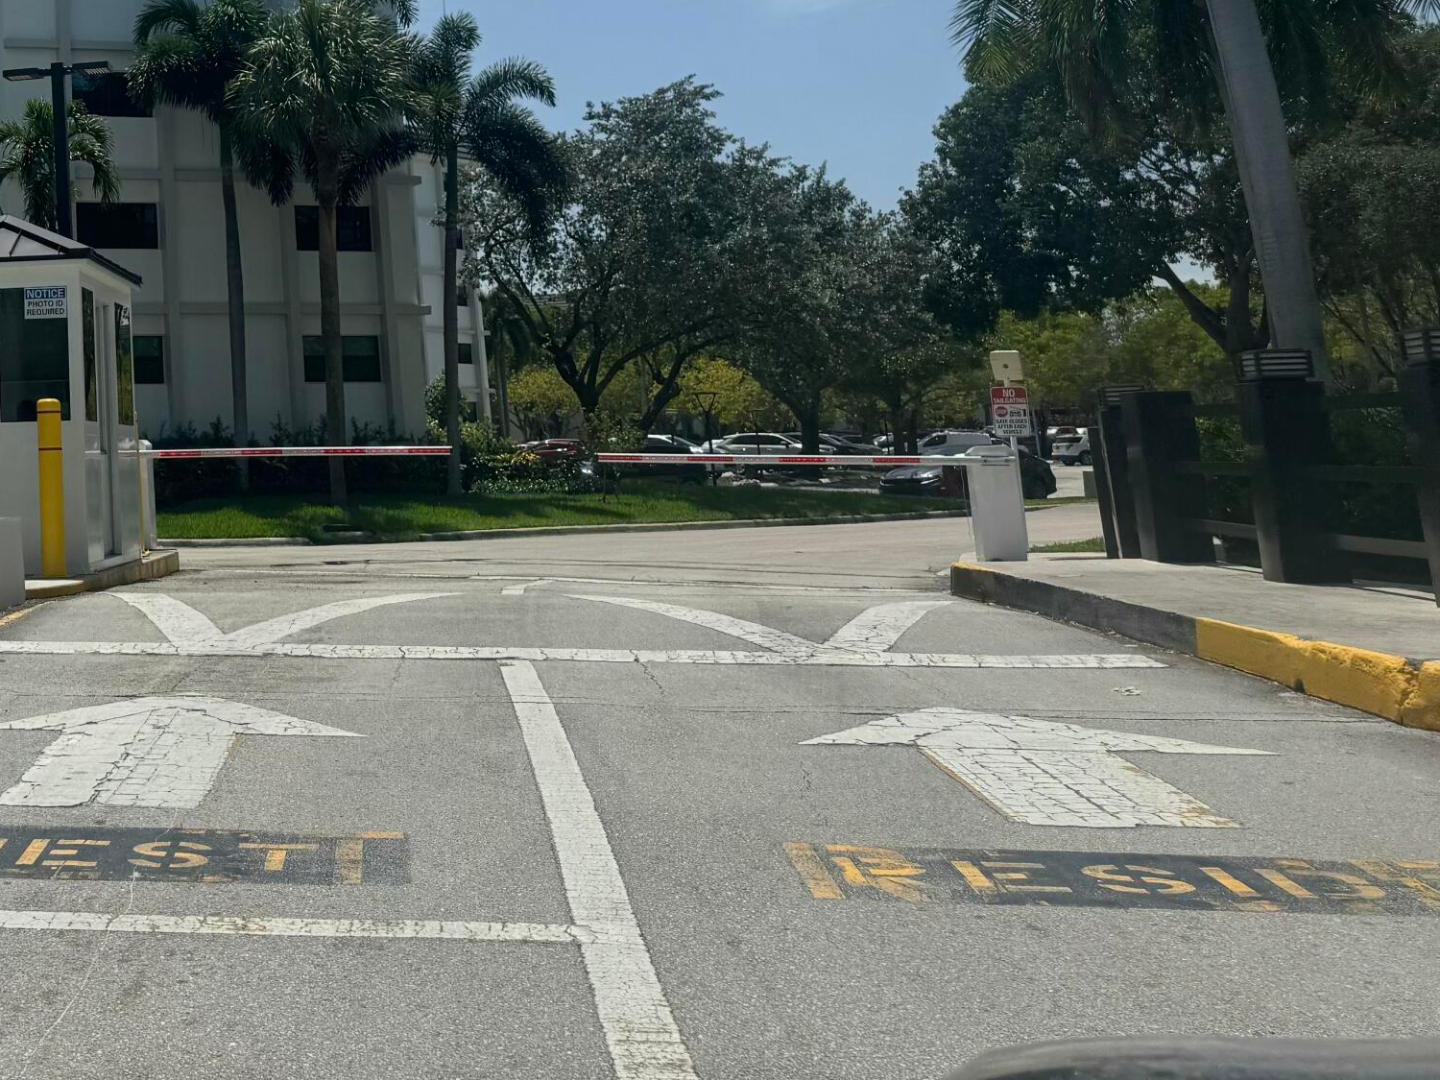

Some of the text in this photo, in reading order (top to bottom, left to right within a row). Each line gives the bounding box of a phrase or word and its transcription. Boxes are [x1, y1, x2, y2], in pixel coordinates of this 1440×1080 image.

[26, 289, 65, 299] NOTICE
[26, 308, 65, 316] REQUIRED
[1002, 388, 1016, 397] NO
[824, 843, 1440, 904] RESID
